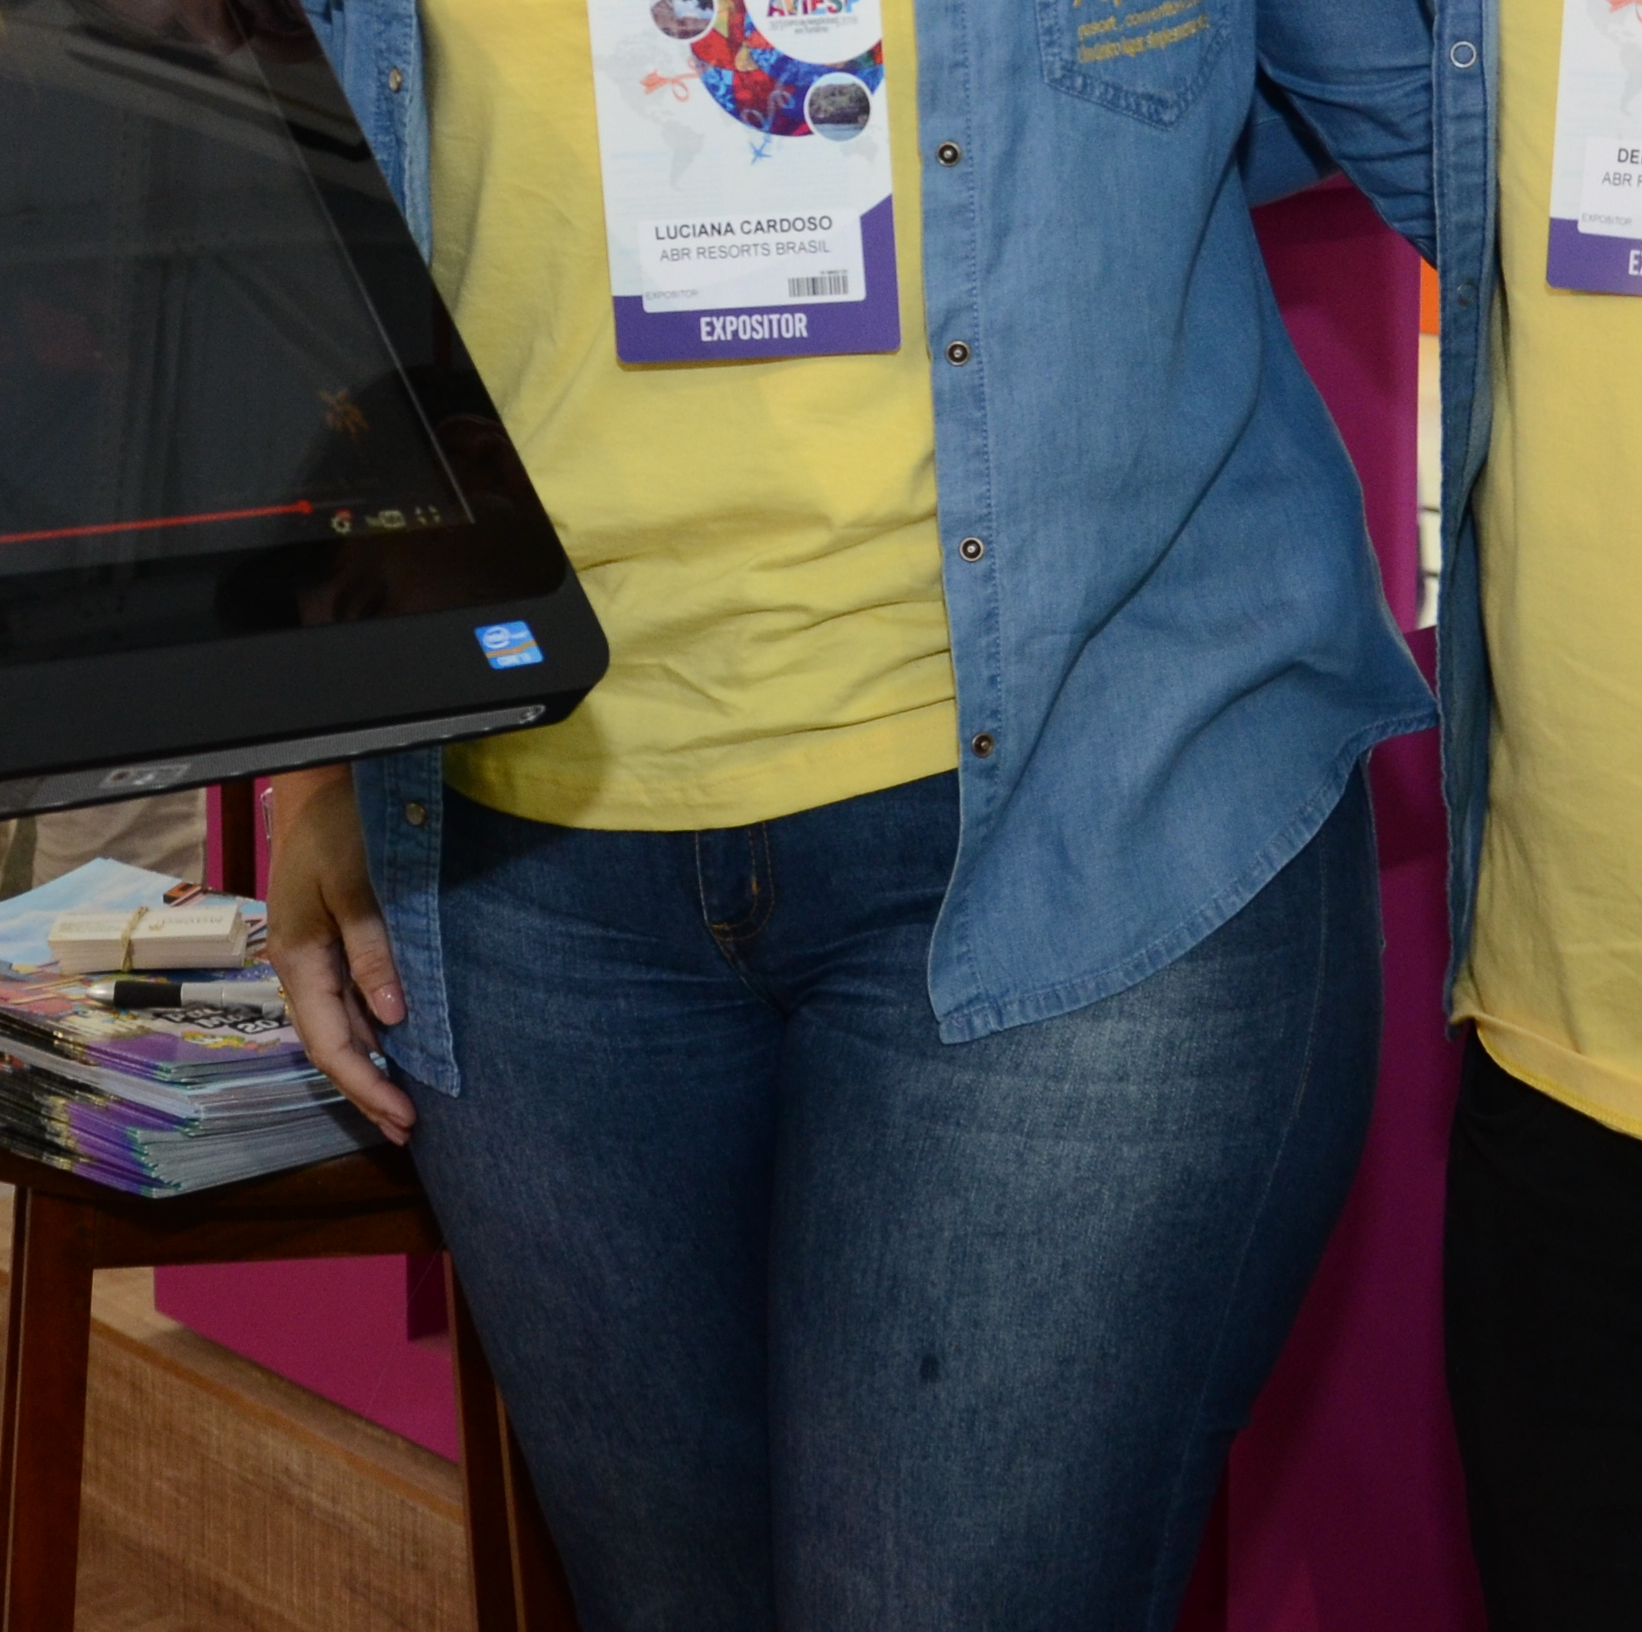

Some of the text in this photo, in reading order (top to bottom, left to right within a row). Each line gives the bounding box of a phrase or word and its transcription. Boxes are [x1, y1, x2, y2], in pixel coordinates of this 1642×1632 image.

[1602, 171, 1633, 187] ABR
[655, 215, 833, 240] LUCIANA CARDOSO
[660, 239, 831, 262] ABR RESORTS BRASIL
[699, 312, 809, 342] EXPOSITOR
